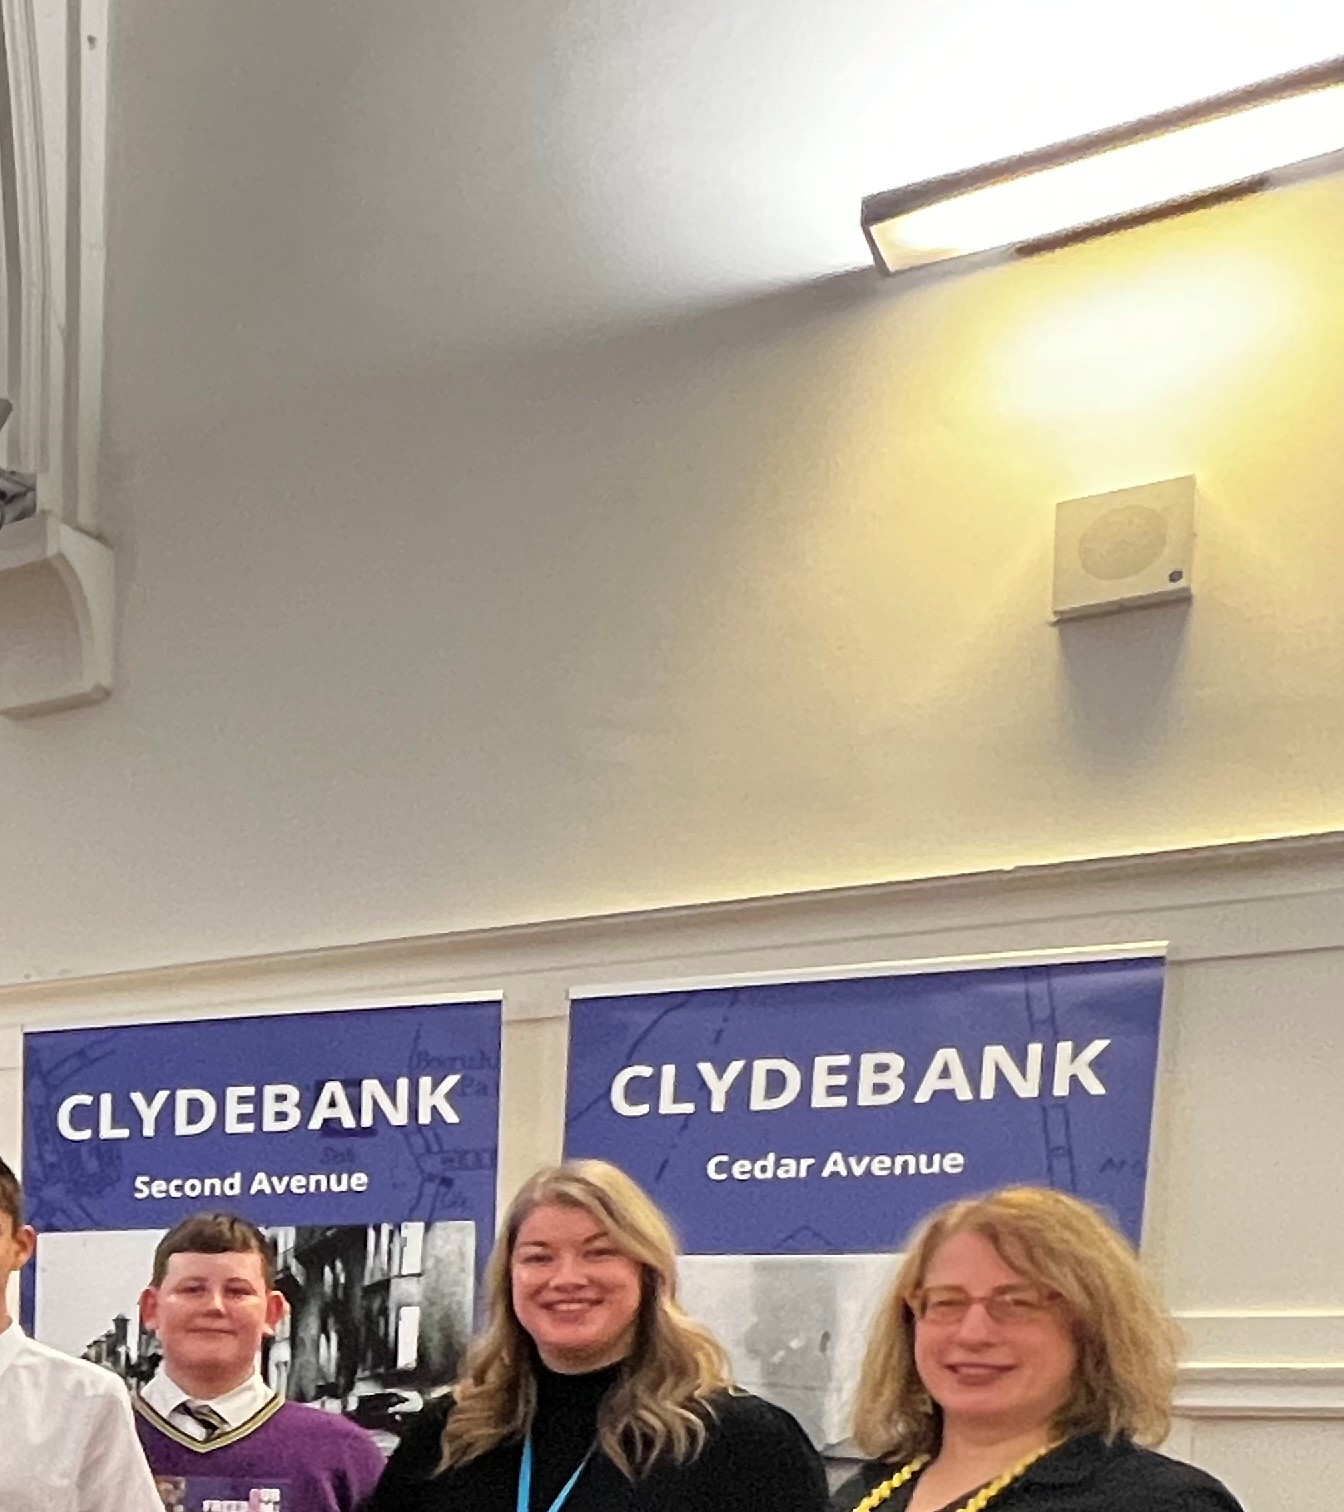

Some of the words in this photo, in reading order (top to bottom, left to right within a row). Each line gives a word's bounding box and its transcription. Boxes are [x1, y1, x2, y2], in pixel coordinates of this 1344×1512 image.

[610, 1038, 1112, 1117] CLYDEBANK
[56, 1073, 462, 1141] CLYDEBANK
[134, 1171, 242, 1199] Second
[249, 1171, 369, 1196] Avenue
[706, 1152, 816, 1181] Cedar
[820, 1151, 966, 1178] Avenue
